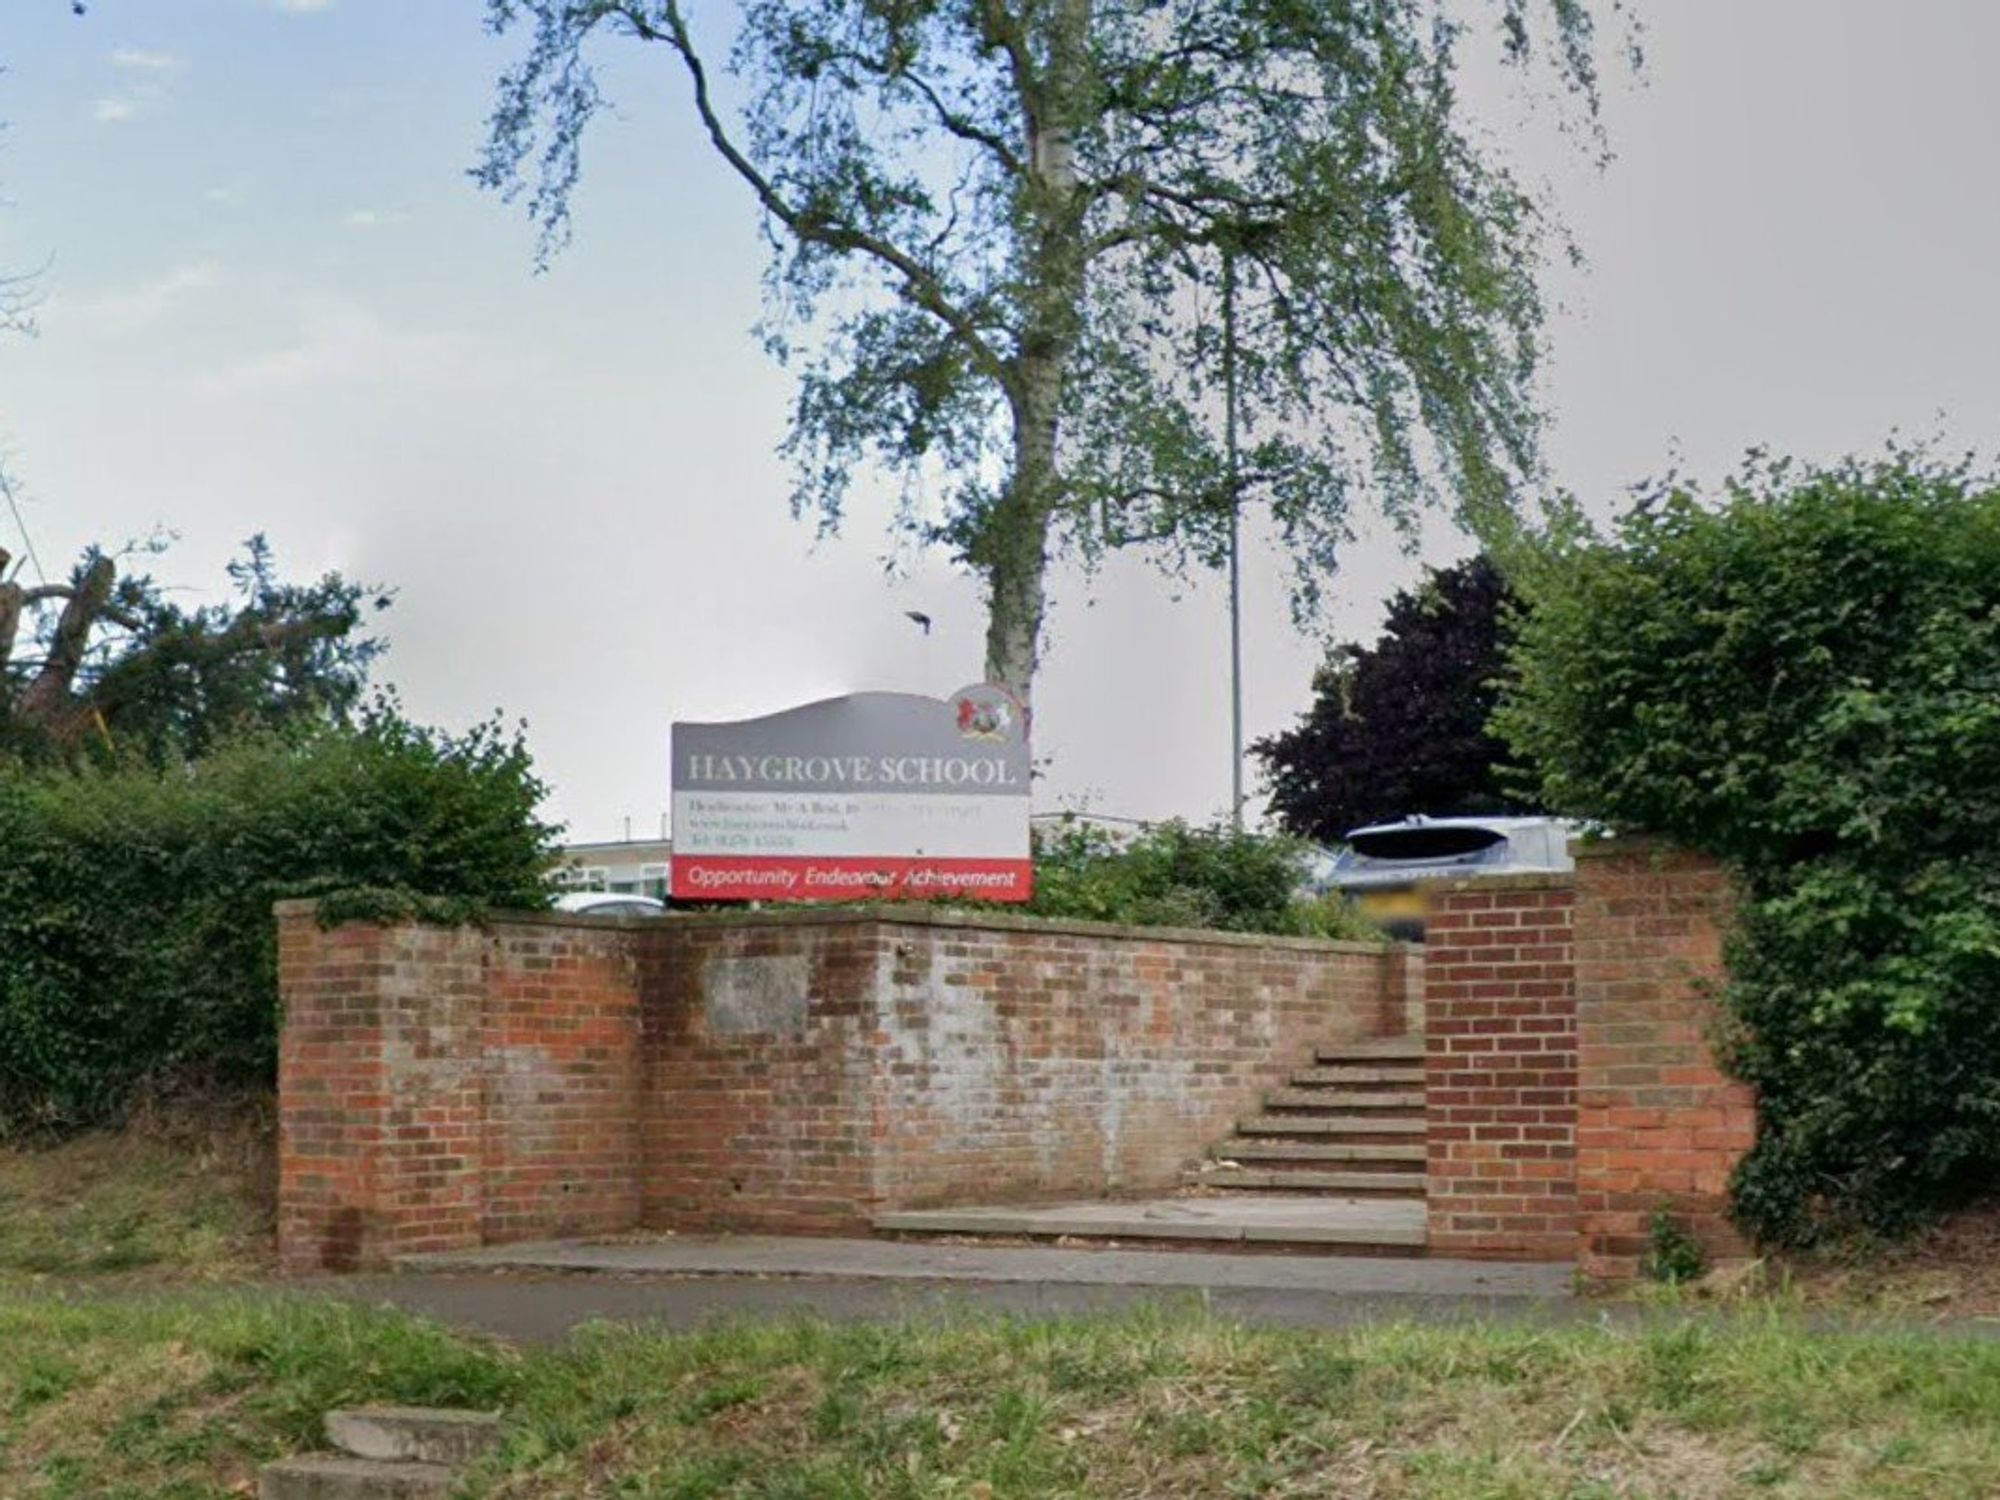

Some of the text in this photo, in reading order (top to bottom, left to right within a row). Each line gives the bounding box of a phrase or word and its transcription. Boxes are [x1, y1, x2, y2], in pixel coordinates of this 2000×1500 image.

[688, 755, 1016, 785] HAYGROVE SCHOOL
[688, 865, 798, 888] Opportunity
